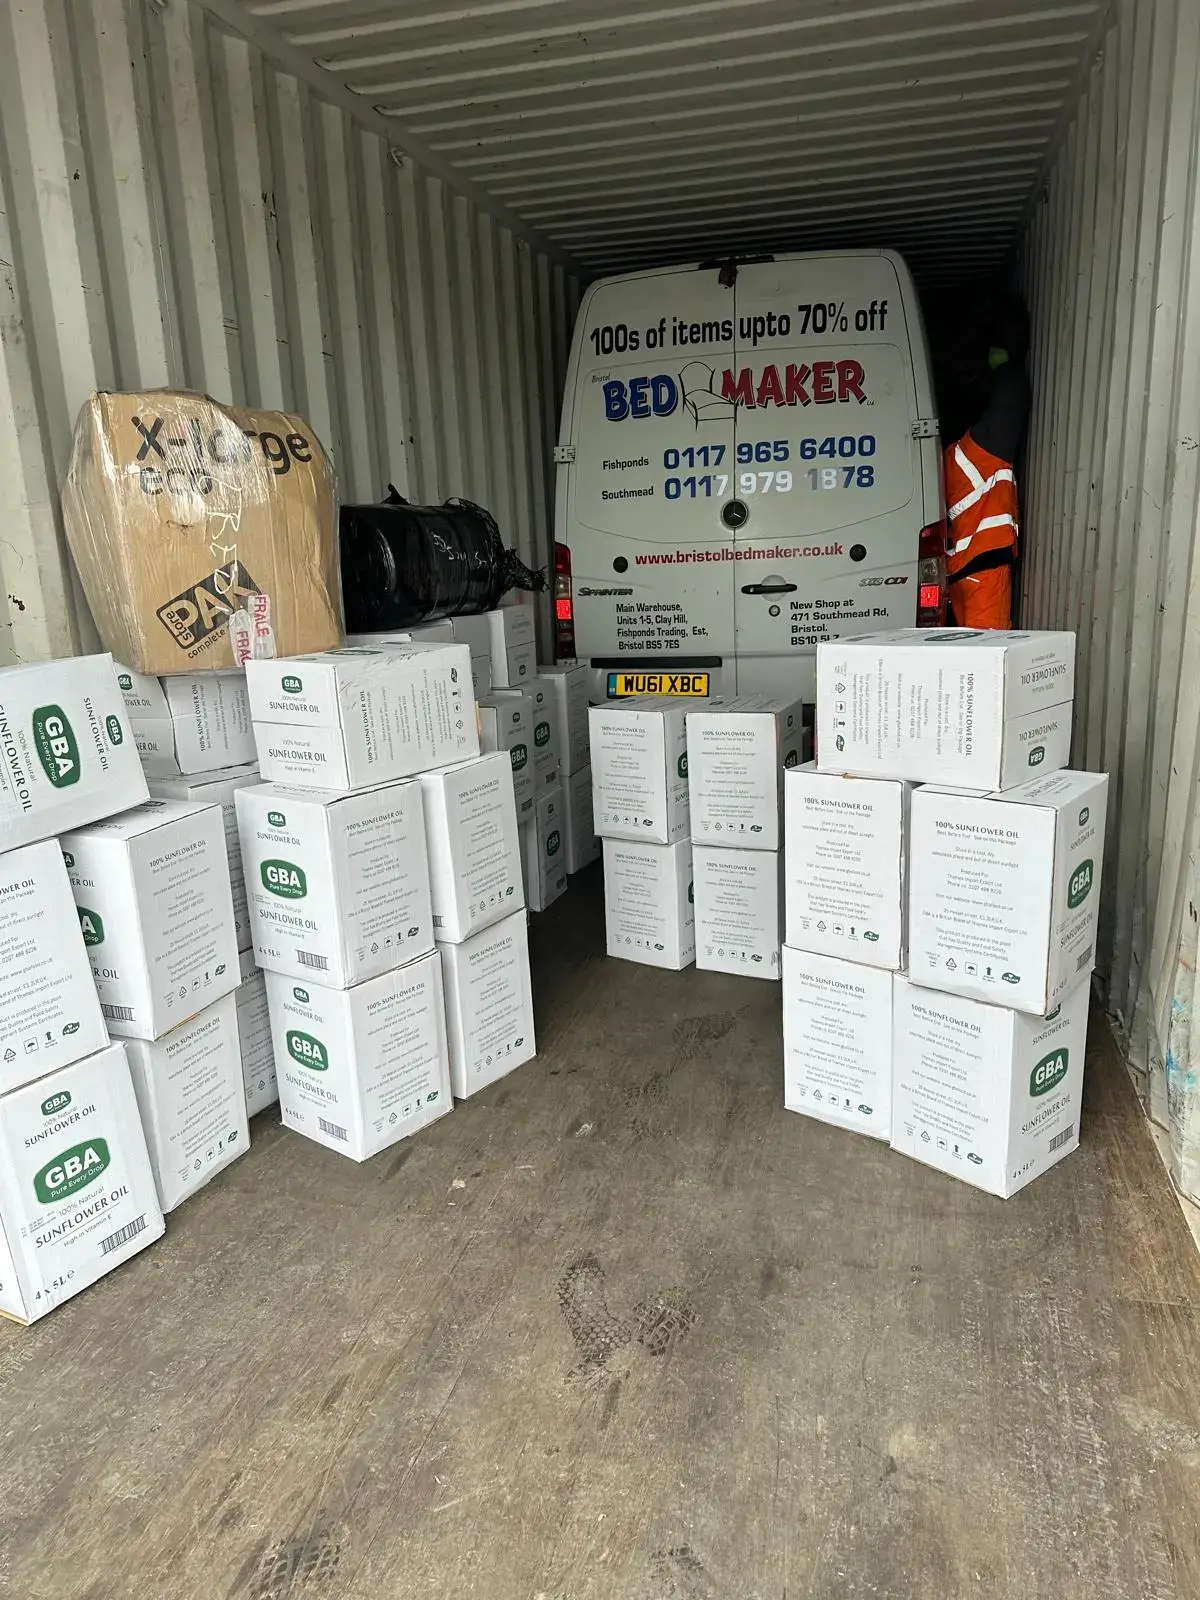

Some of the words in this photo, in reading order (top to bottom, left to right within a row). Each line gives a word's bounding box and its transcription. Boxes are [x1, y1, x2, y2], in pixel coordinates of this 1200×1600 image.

[590, 323, 640, 356] 100s
[645, 317, 666, 349] of
[672, 316, 733, 346] items
[739, 311, 791, 346] upto
[798, 302, 848, 335] 70%
[855, 300, 888, 331] off
[602, 374, 678, 422] BED
[720, 360, 867, 409] MAKER
[131, 416, 312, 475] X-large
[602, 456, 650, 471] Fishponds
[663, 443, 727, 470] 0117
[736, 439, 790, 465] 965
[799, 434, 876, 460] 6400
[140, 467, 213, 496] eco
[601, 486, 654, 501] Southmead
[664, 474, 729, 500] 0117
[739, 469, 793, 494] 979
[804, 465, 875, 491] 1878
[635, 543, 844, 565] www.bristolbedmaker.co.uk
[616, 603, 635, 613] Main
[636, 602, 683, 613] Warehouse,
[790, 601, 813, 610] New
[815, 599, 840, 609] Shop
[843, 598, 854, 606] at
[791, 612, 809, 621] 471
[813, 608, 870, 620] Southmead
[873, 607, 889, 617] Rd,
[166, 610, 192, 641] store
[617, 615, 637, 625] Units
[639, 615, 654, 626] 1-5,
[655, 615, 672, 626] Clay
[673, 614, 688, 624] Hill,
[791, 623, 828, 633] Bristol.
[617, 628, 655, 639] Fishponds
[656, 627, 689, 638] Trading,
[692, 626, 709, 636] Est,
[791, 635, 818, 645] BS10
[187, 629, 226, 659] complete
[618, 640, 644, 650] Bristol
[646, 640, 662, 650] BS5
[664, 639, 680, 649] 7ES
[284, 679, 300, 689] GBA
[624, 675, 663, 693] WU61
[668, 675, 703, 693] XBC
[1021, 674, 1031, 685] OIL
[1032, 663, 1067, 684] SUNFLOWER
[194, 695, 204, 735] SUNFLOWER
[269, 701, 308, 712] SUNFLOWER
[309, 704, 320, 713] OIL
[966, 693, 974, 742] SUNFLOWER
[84, 697, 105, 755] SUNFLOWER
[100, 756, 111, 772] OIL
[110, 718, 121, 742] GBA
[361, 703, 372, 746] SUNFLOWER
[536, 726, 549, 739] GBA
[1028, 722, 1058, 739] SUNFLOWER
[45, 716, 75, 778] GBA
[147, 742, 158, 751] OIL
[1019, 732, 1028, 742] OIL
[18, 730, 27, 750] 100%
[23, 752, 37, 782] Natural
[37, 722, 46, 740] Pure
[42, 741, 51, 761] Every
[49, 761, 58, 782] Drop
[268, 748, 313, 760] SUNFLOWER
[314, 752, 327, 762] OIL
[511, 748, 526, 764] GBA
[1030, 752, 1043, 764] GBA
[20, 789, 33, 813] OIL
[821, 799, 861, 811] SUNFLOWER
[269, 814, 284, 823] GBA
[361, 812, 394, 827] SUNFLOWER
[1079, 809, 1089, 822] GBA
[257, 831, 291, 844] SUNFLOWER
[291, 836, 301, 846] OIL
[935, 821, 954, 830] 100%
[955, 823, 1004, 837] SUNFLOWER
[1006, 830, 1020, 838] OIL
[149, 856, 165, 867] 100%
[165, 842, 197, 862] SUNFLOWER
[197, 839, 206, 847] OIL
[22, 879, 36, 888] OIL
[83, 879, 95, 888] OIL
[266, 865, 302, 888] GBA
[1071, 866, 1091, 894] GBA
[259, 909, 304, 928] SUNFLOWER
[305, 918, 318, 931] OIL
[1060, 918, 1087, 948] SUNFLOWER
[102, 968, 119, 980] OIL
[799, 973, 814, 982] 100%
[815, 977, 854, 991] SUNFLOWER
[855, 986, 866, 994] OIL
[294, 990, 308, 1000] GBA
[366, 1001, 381, 1011] 100%
[382, 985, 416, 1005] SUNFLOWER
[283, 1003, 314, 1020] SUNFLOWER
[911, 1003, 927, 1014] 100%
[928, 1009, 969, 1029] SUNFLOWER
[970, 1023, 982, 1033] OIL
[166, 1041, 180, 1054] 100%
[180, 1023, 212, 1047] SUNFLOWER
[1032, 1022, 1061, 1045] SUNFLOWER
[1062, 1018, 1070, 1028] OIL
[291, 1036, 324, 1062] GBA
[1035, 1055, 1064, 1085] GBA
[285, 1073, 326, 1097] SUNFLOWER
[326, 1092, 339, 1104] OIL
[45, 1094, 68, 1110] GBA
[1021, 1101, 1060, 1135] SUNFLOWER
[1061, 1094, 1071, 1107] OIL
[24, 1113, 81, 1148] SUNFLOWER
[83, 1104, 97, 1116] OIL
[45, 1147, 102, 1189] GBA
[51, 1184, 67, 1198] Pure
[68, 1174, 87, 1190] Every
[88, 1163, 105, 1179] Drop
[59, 1203, 78, 1217] 100%
[79, 1186, 105, 1207] Natural
[35, 1198, 110, 1249] SUNFLOWER
[111, 1184, 130, 1201] OIL
[35, 1290, 42, 1300] 4
